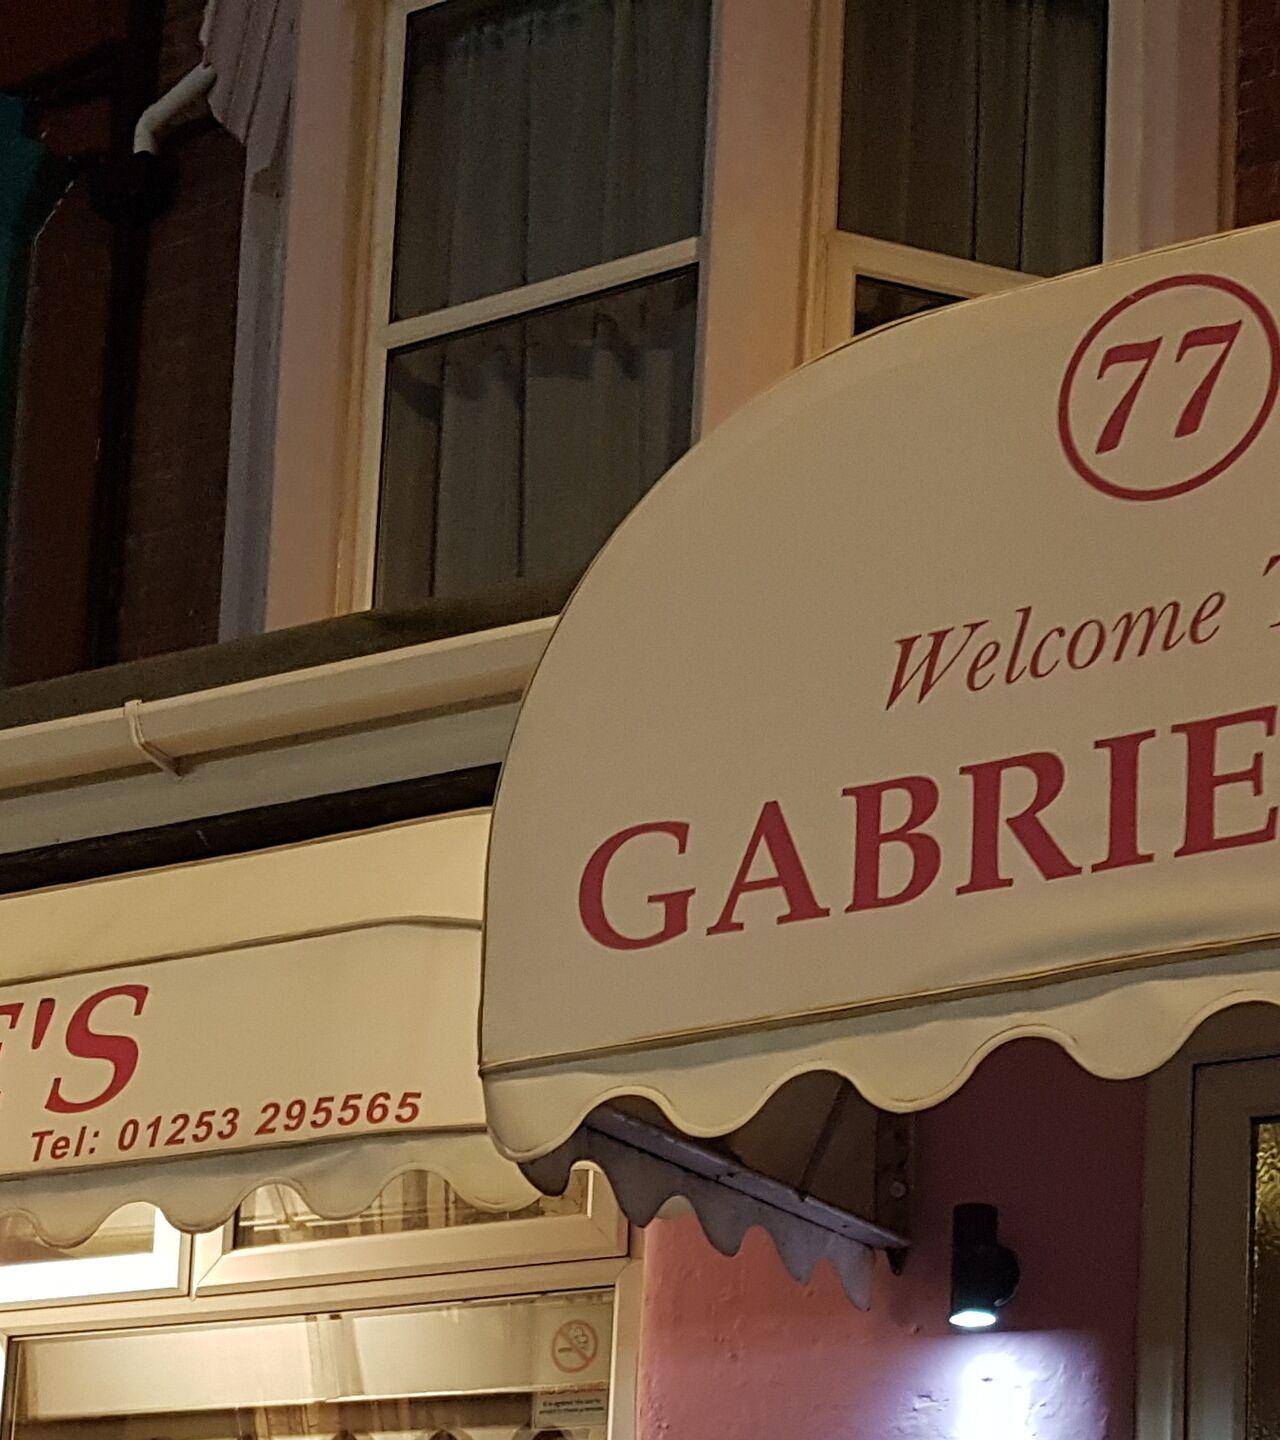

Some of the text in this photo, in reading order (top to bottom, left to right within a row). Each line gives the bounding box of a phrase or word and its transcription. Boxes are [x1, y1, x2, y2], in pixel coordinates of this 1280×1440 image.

[1094, 319, 1243, 455] 77
[884, 591, 1226, 711] Welcome
[30, 1091, 423, 1162] Tel: 01253 295565
